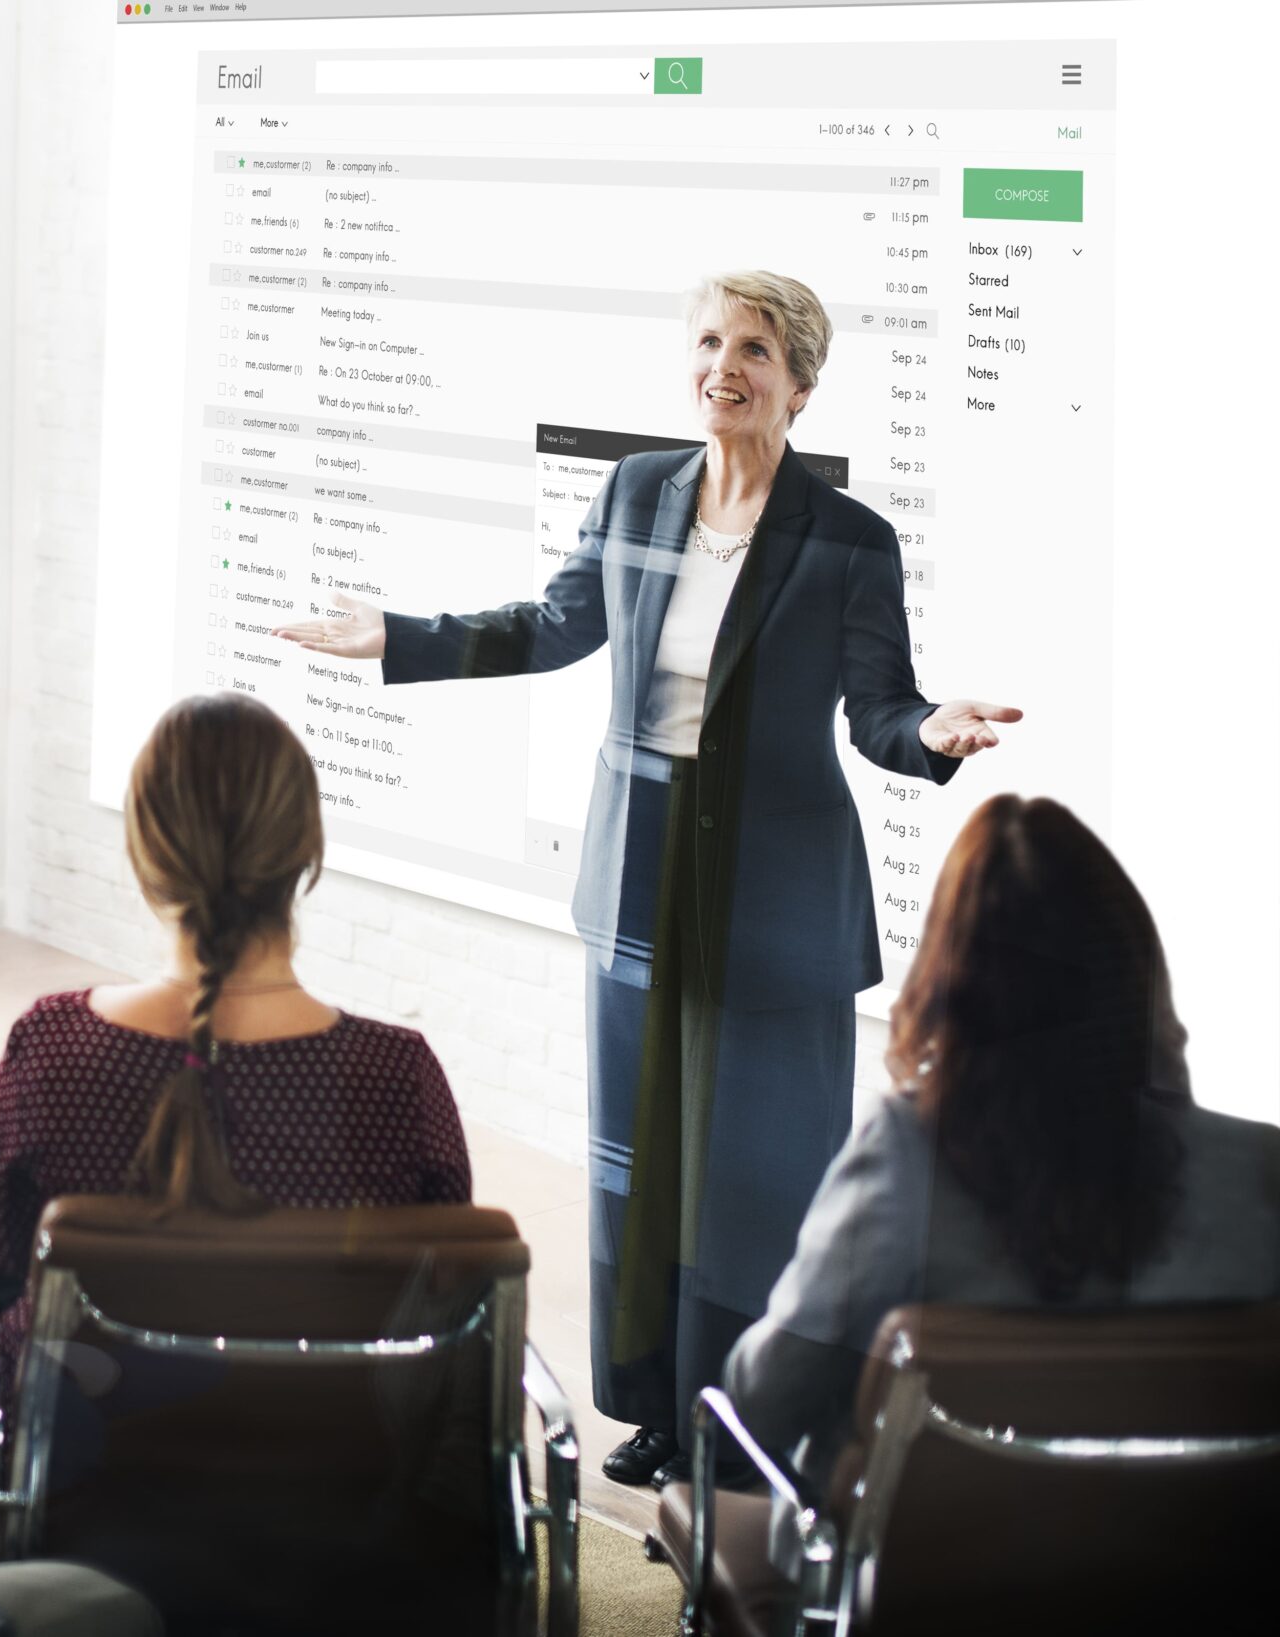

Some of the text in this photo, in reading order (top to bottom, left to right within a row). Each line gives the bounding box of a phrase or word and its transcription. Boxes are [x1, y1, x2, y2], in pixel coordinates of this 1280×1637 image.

[165, 2, 246, 12] File Edit View Window Help
[218, 64, 262, 88] Email
[216, 116, 225, 126] All
[261, 116, 279, 127] More
[846, 123, 855, 134] of
[858, 124, 874, 135] 346
[1058, 125, 1082, 139] Mail
[253, 159, 300, 169] me,custormer
[326, 159, 392, 174] Re company info
[891, 176, 929, 190] 11:27 pm
[252, 186, 271, 197] email
[326, 188, 369, 204] (no subject)
[995, 188, 1049, 202] COMPOSE
[251, 215, 287, 227] me,friends
[324, 217, 362, 230] Re 2 new
[892, 211, 928, 226] 11:15 pm
[250, 245, 307, 256] custormer no.249
[323, 247, 389, 263] Re company info
[887, 246, 928, 261] 10:45 pm
[969, 241, 1032, 260] Inbox (169)
[249, 274, 296, 285] me,custormer
[322, 276, 388, 293] Re company info
[969, 272, 1008, 287] Starred
[886, 281, 927, 294] 10:30 am
[248, 303, 295, 314] me,custormer
[321, 306, 374, 323] Meeting today
[969, 302, 1019, 319] Sent Mail
[885, 316, 927, 329] 09:01 am
[246, 329, 269, 341] Join us
[320, 335, 336, 347] New
[368, 343, 377, 351] on
[380, 340, 418, 356] Computer
[969, 333, 1025, 354] Drafts (10)
[892, 349, 926, 366] Sep 24
[246, 360, 292, 372] me,custormer
[968, 365, 999, 380] Notes
[319, 364, 433, 388] Re On 23 October at 09:00,
[244, 388, 263, 399] email
[892, 385, 926, 403] Sep 24
[318, 394, 413, 415] What do you think so far?
[968, 396, 995, 411] More
[243, 418, 277, 429] custormer
[891, 420, 925, 438] Sep 23
[317, 427, 366, 441] company info
[544, 433, 576, 445] New Email
[242, 447, 276, 458] custormer
[316, 453, 360, 472] (no subject)
[543, 461, 550, 471] To
[559, 465, 604, 477] me,custormer
[890, 456, 925, 474] Sep 23
[241, 476, 288, 490] me,custormer
[315, 487, 367, 501] we want some
[543, 487, 566, 500] Subject
[574, 491, 590, 502] have
[890, 492, 924, 509] Sep 23
[240, 504, 287, 518] me,custormer
[314, 512, 380, 533] Re company info
[542, 520, 550, 532] Hi,
[239, 533, 258, 544] email
[916, 533, 924, 544] 21
[313, 542, 357, 563] (no subject)
[541, 543, 561, 559] Today
[237, 561, 274, 576] me,friends
[915, 570, 923, 581] 18
[312, 572, 350, 589] Re 2 new
[236, 592, 294, 609] custormer no.249
[310, 602, 319, 614] Re
[915, 606, 923, 617] 15
[234, 650, 282, 667] me,custormer
[308, 663, 362, 687] Meeting today
[233, 677, 255, 692] Join us
[307, 693, 323, 706] New
[356, 706, 365, 715] on
[367, 705, 405, 724] Computer
[306, 723, 394, 755] Re On Sep at 11:00,
[327, 759, 401, 787] do you think so far?
[884, 781, 920, 801] Aug 27
[340, 794, 354, 806] info
[884, 818, 920, 838] Aug 25
[883, 854, 919, 874] Aug 22
[885, 891, 919, 912] Aug 21
[885, 928, 906, 949] Aug
